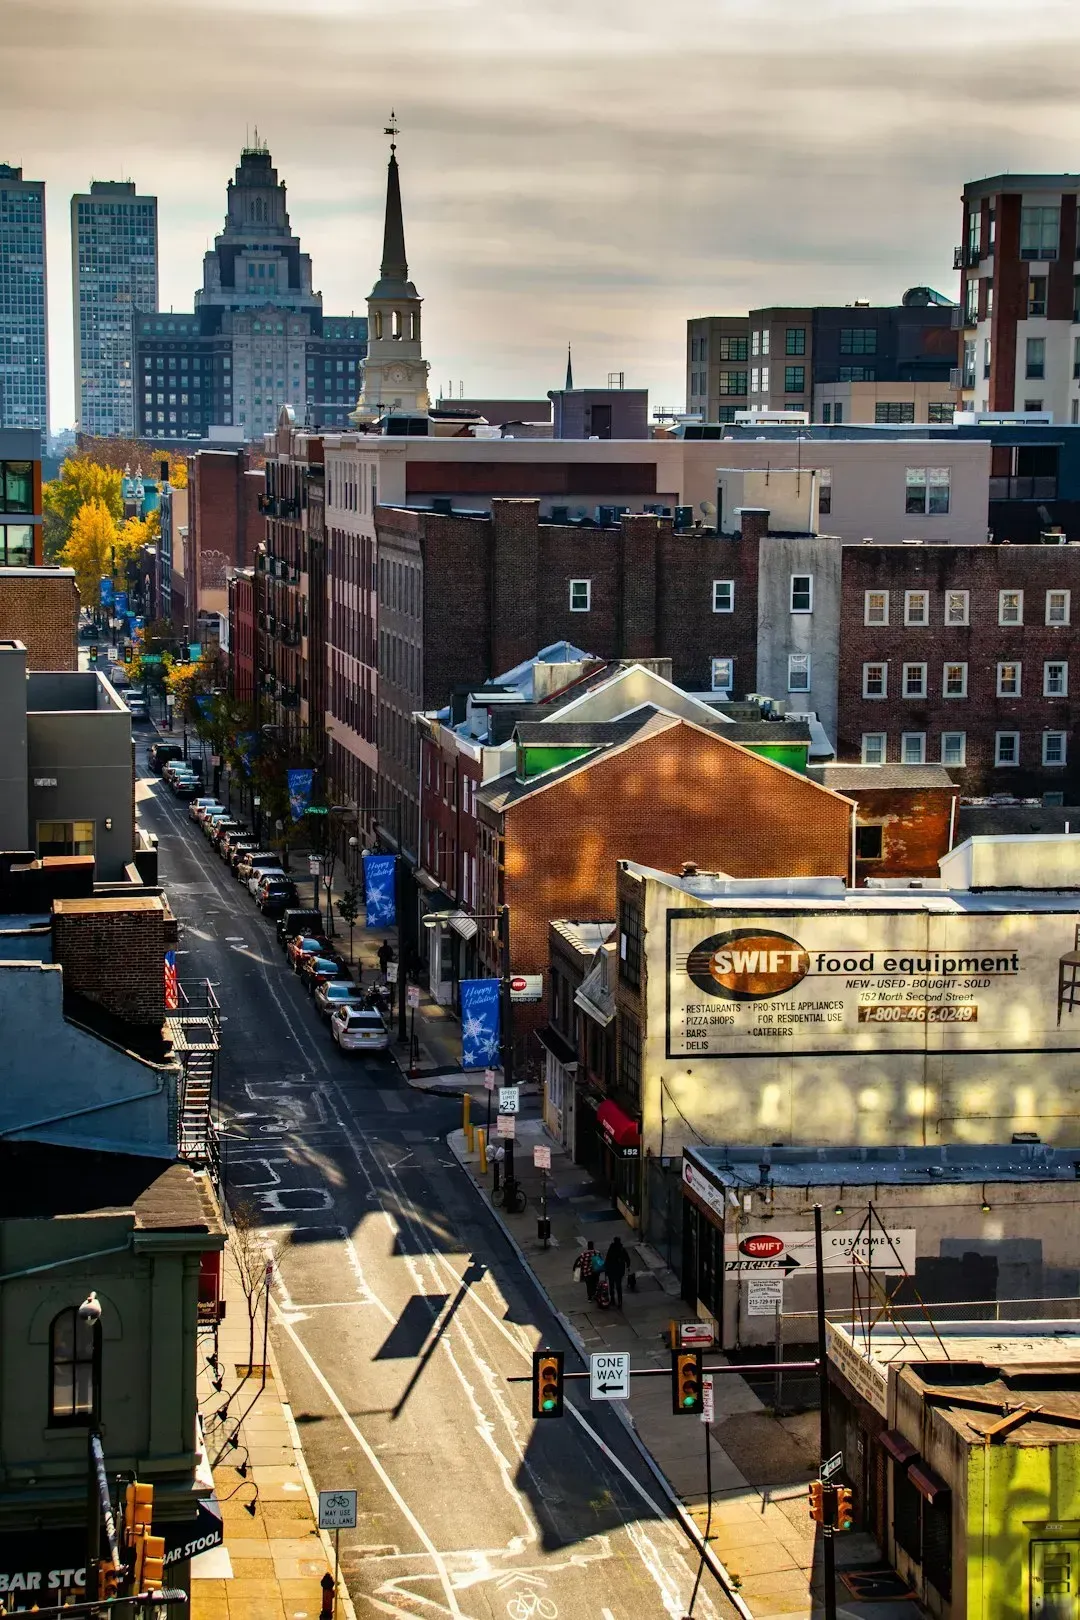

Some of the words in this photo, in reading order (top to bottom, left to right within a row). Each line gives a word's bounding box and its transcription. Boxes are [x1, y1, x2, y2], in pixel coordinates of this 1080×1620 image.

[714, 950, 804, 974] SWIFT
[816, 952, 874, 972] food
[883, 953, 1019, 975] equipment
[846, 980, 870, 989] NEW
[877, 980, 906, 988] USED
[911, 979, 956, 989] BOUGHT
[963, 979, 991, 988] SOLD
[465, 986, 492, 998] Happy
[860, 992, 876, 1001] 152
[878, 992, 903, 1001] North
[905, 992, 943, 1001] Second
[945, 992, 974, 1001] Street
[686, 1003, 741, 1014] RESTAURANTS
[797, 1000, 844, 1011] APPLIANCES
[686, 1016, 709, 1026] PIZZA
[709, 1015, 735, 1025] SHOPS
[757, 1014, 773, 1024] FOR
[777, 1013, 826, 1023] RESIDENTIAL
[827, 1013, 843, 1022] USE
[686, 1029, 707, 1038] BARS
[753, 1027, 793, 1037] CATERERS
[686, 1041, 709, 1050] DELIS
[503, 1100, 516, 1110] 25
[622, 1148, 638, 1156] 152
[749, 1242, 782, 1251] SWIFT
[831, 1237, 901, 1246] CUSTOMERS
[725, 1261, 780, 1271] PARKING
[597, 1357, 624, 1368] ONE
[597, 1369, 624, 1380] WAY
[324, 1509, 337, 1517] MAY
[339, 1517, 354, 1525] LANE
[184, 1530, 222, 1557] STOOL
